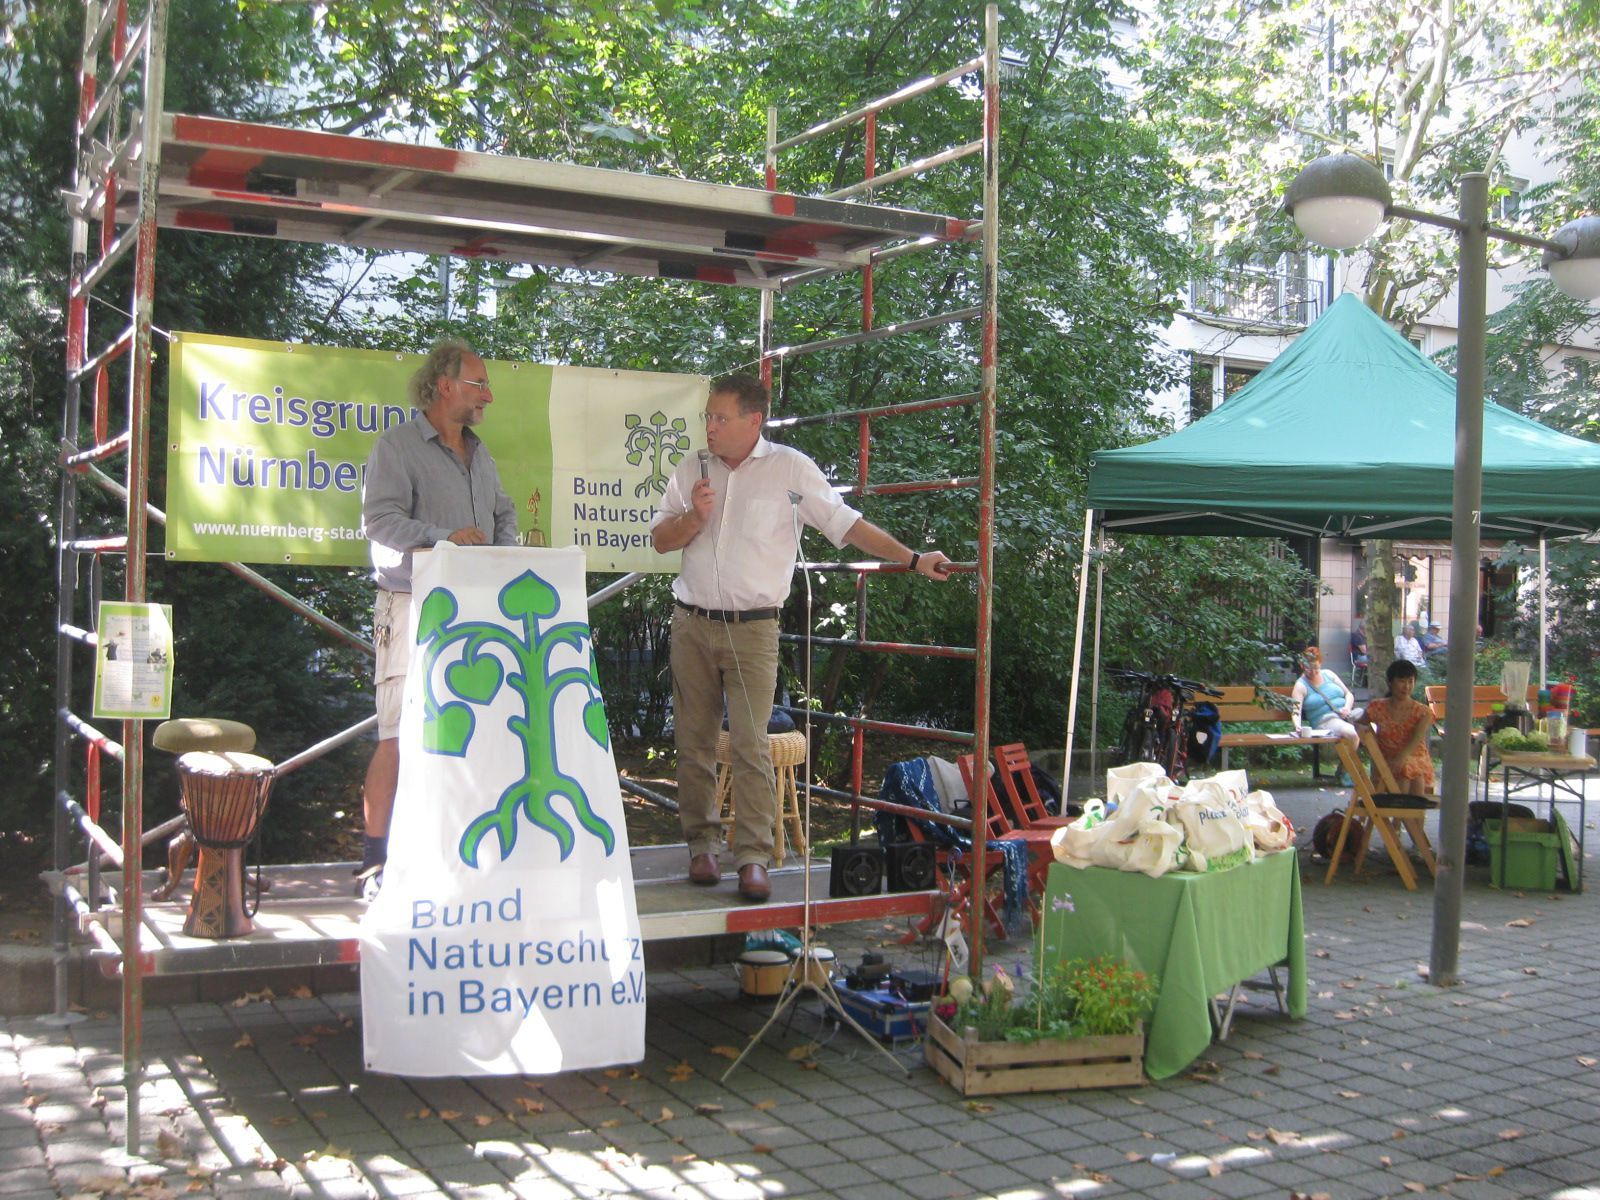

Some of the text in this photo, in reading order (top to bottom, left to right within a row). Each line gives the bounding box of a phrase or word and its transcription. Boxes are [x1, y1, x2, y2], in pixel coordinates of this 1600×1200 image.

[199, 381, 418, 438] Kreisgrup
[198, 446, 366, 492] Nürnbe
[573, 477, 622, 497] Bund
[573, 502, 658, 523] Natursch
[573, 528, 591, 547] in
[411, 887, 522, 930] Bund
[408, 929, 641, 971] Naturschuz
[408, 970, 645, 1019] in Bayern e.V.
